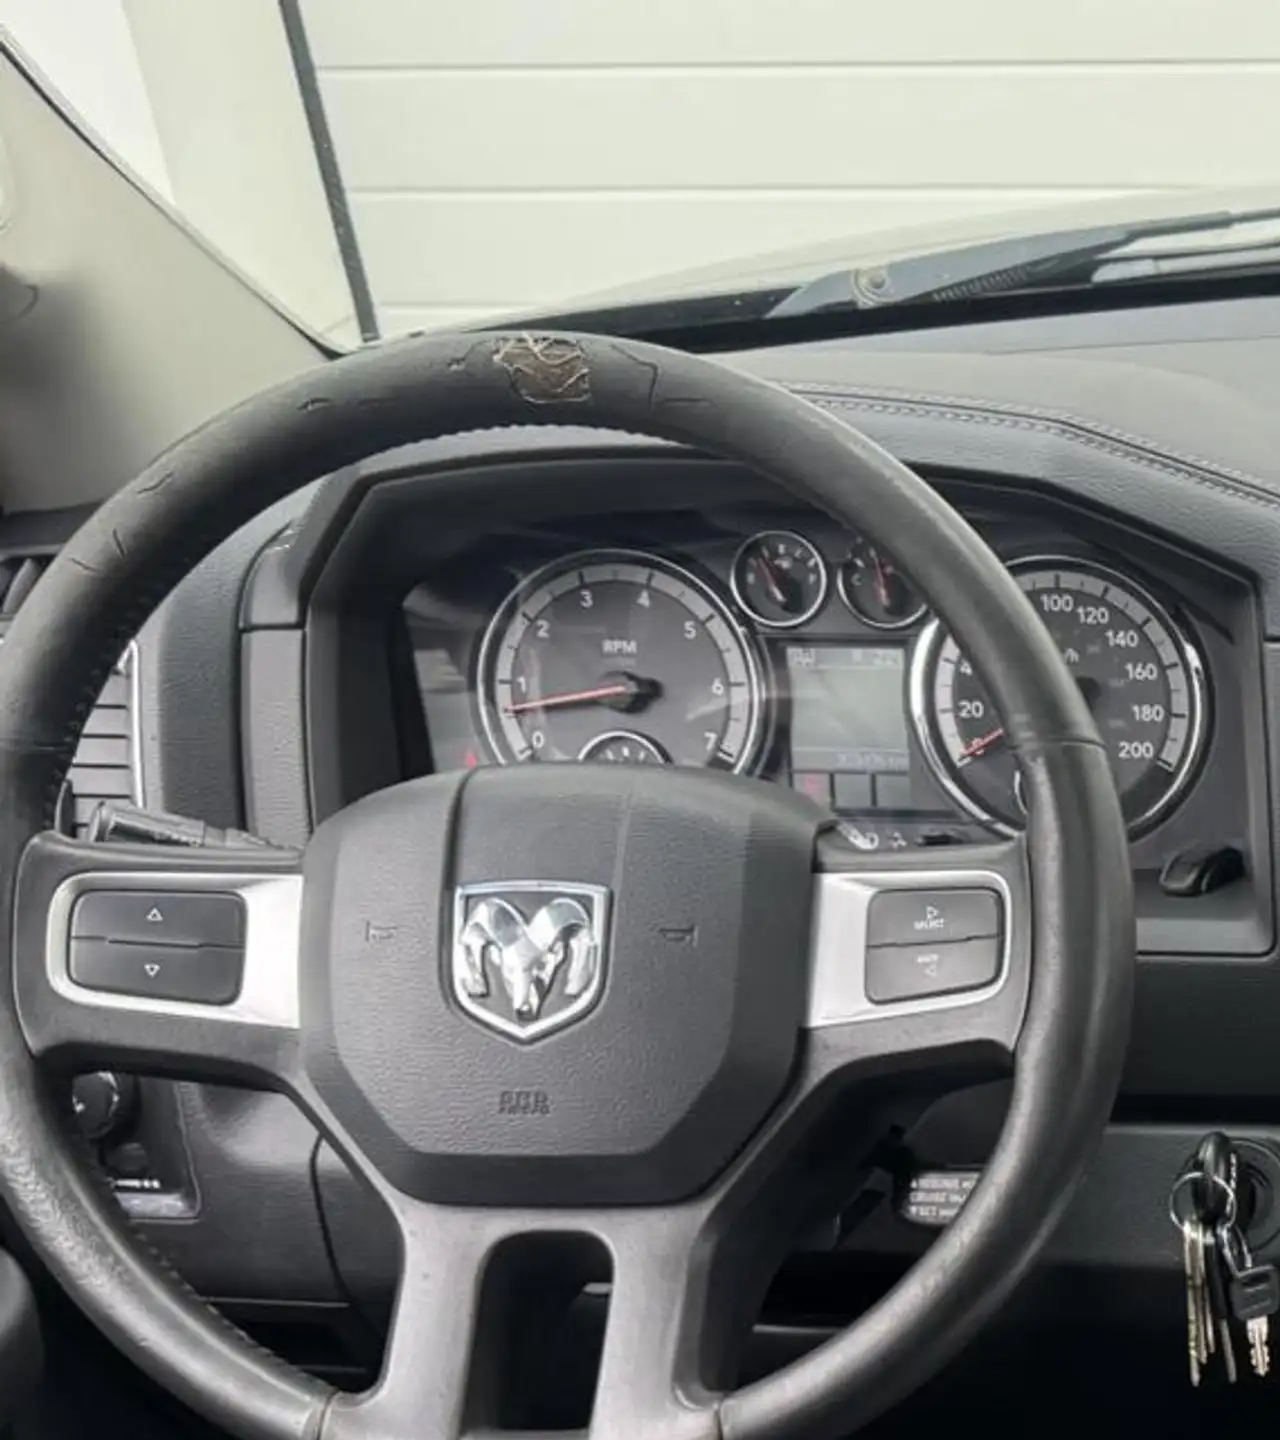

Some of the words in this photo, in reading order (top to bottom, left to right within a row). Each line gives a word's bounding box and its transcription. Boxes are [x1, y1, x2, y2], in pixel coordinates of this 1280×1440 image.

[579, 589, 593, 608] 3
[636, 589, 650, 607] 4
[1040, 594, 1074, 612] 100
[1076, 607, 1109, 625] 120
[536, 619, 551, 638] 2
[684, 619, 697, 639] 5
[603, 639, 638, 654] RPM
[1105, 629, 1139, 648] 140
[1124, 663, 1157, 681] 160
[517, 675, 528, 692] 1
[711, 681, 725, 696] 6
[958, 701, 985, 718] 20
[1131, 704, 1165, 722] 180
[532, 730, 545, 749] 0
[704, 732, 718, 751] 7
[1118, 741, 1154, 758] 200
